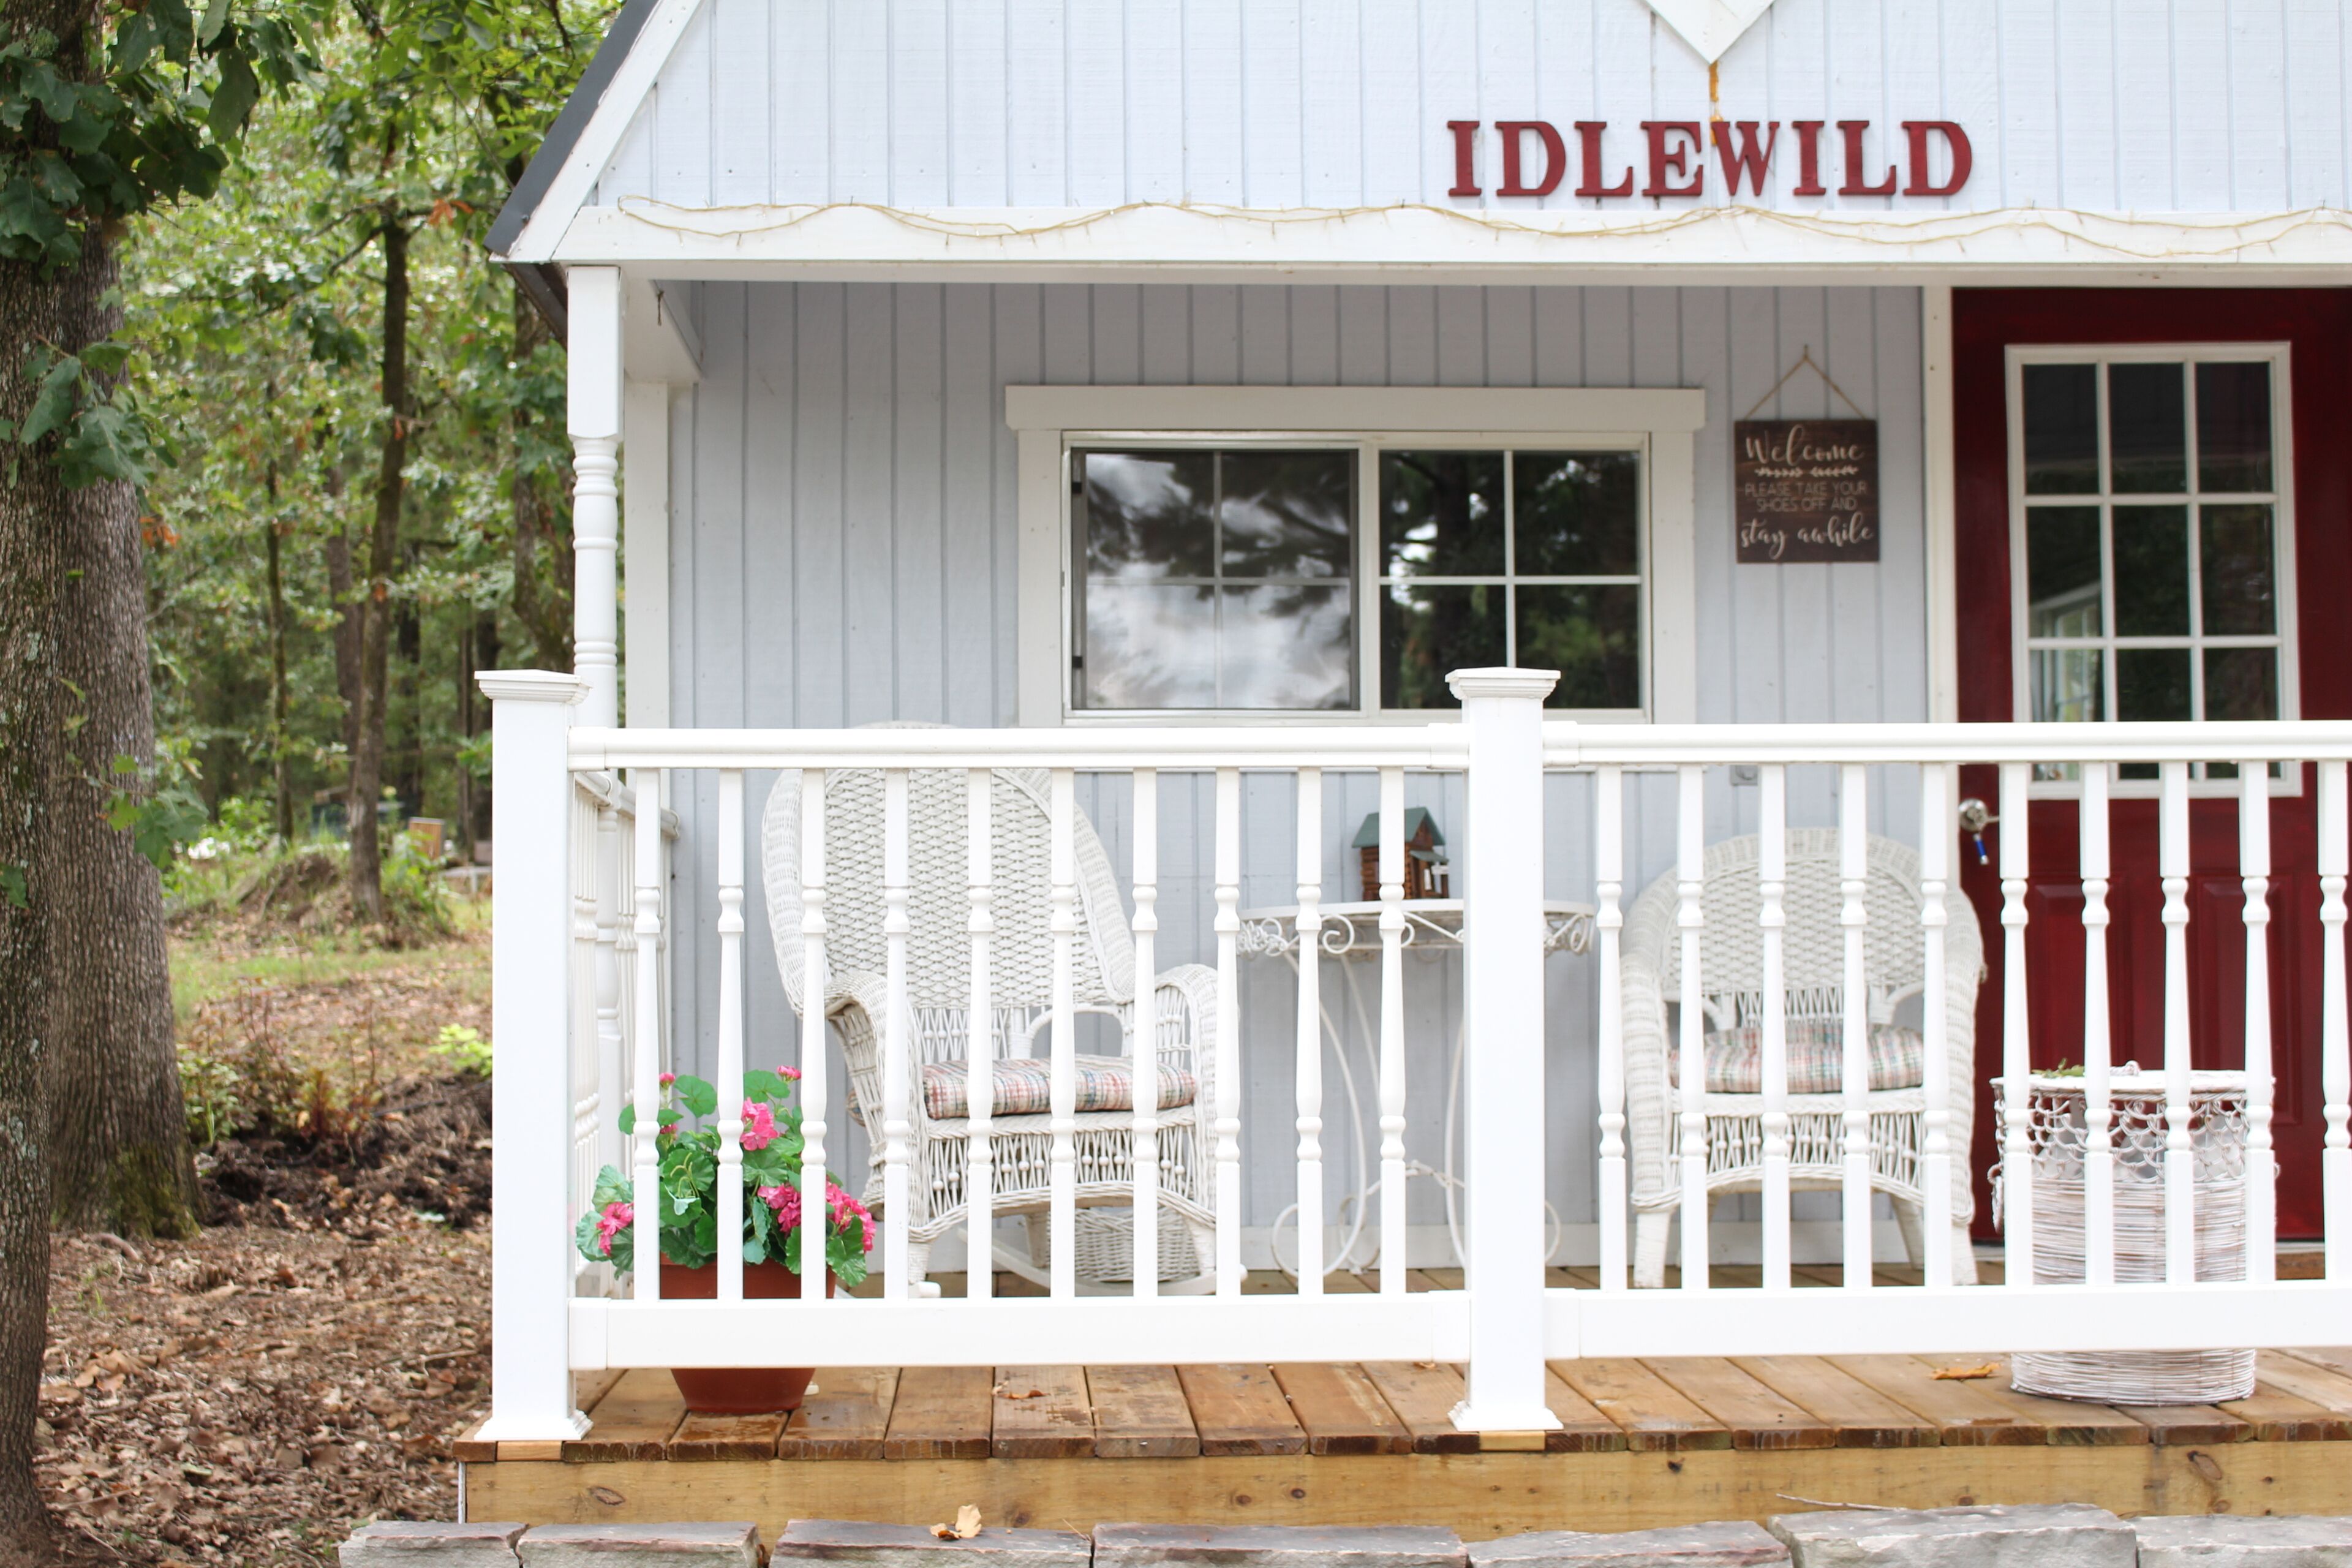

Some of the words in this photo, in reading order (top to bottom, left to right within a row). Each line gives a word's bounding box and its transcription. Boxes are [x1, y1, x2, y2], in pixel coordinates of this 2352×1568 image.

[1447, 121, 1972, 197] IDLEWILD
[1746, 424, 1865, 465] Welcome
[1745, 483, 1790, 497] PLEASE
[1795, 481, 1828, 496] TAKE
[1832, 481, 1867, 496] YOUR
[1756, 498, 1798, 513] SHOES
[1801, 498, 1826, 511] OFF
[1831, 497, 1856, 510] AND
[1741, 518, 1786, 560] stay
[1798, 512, 1874, 547] awhile
